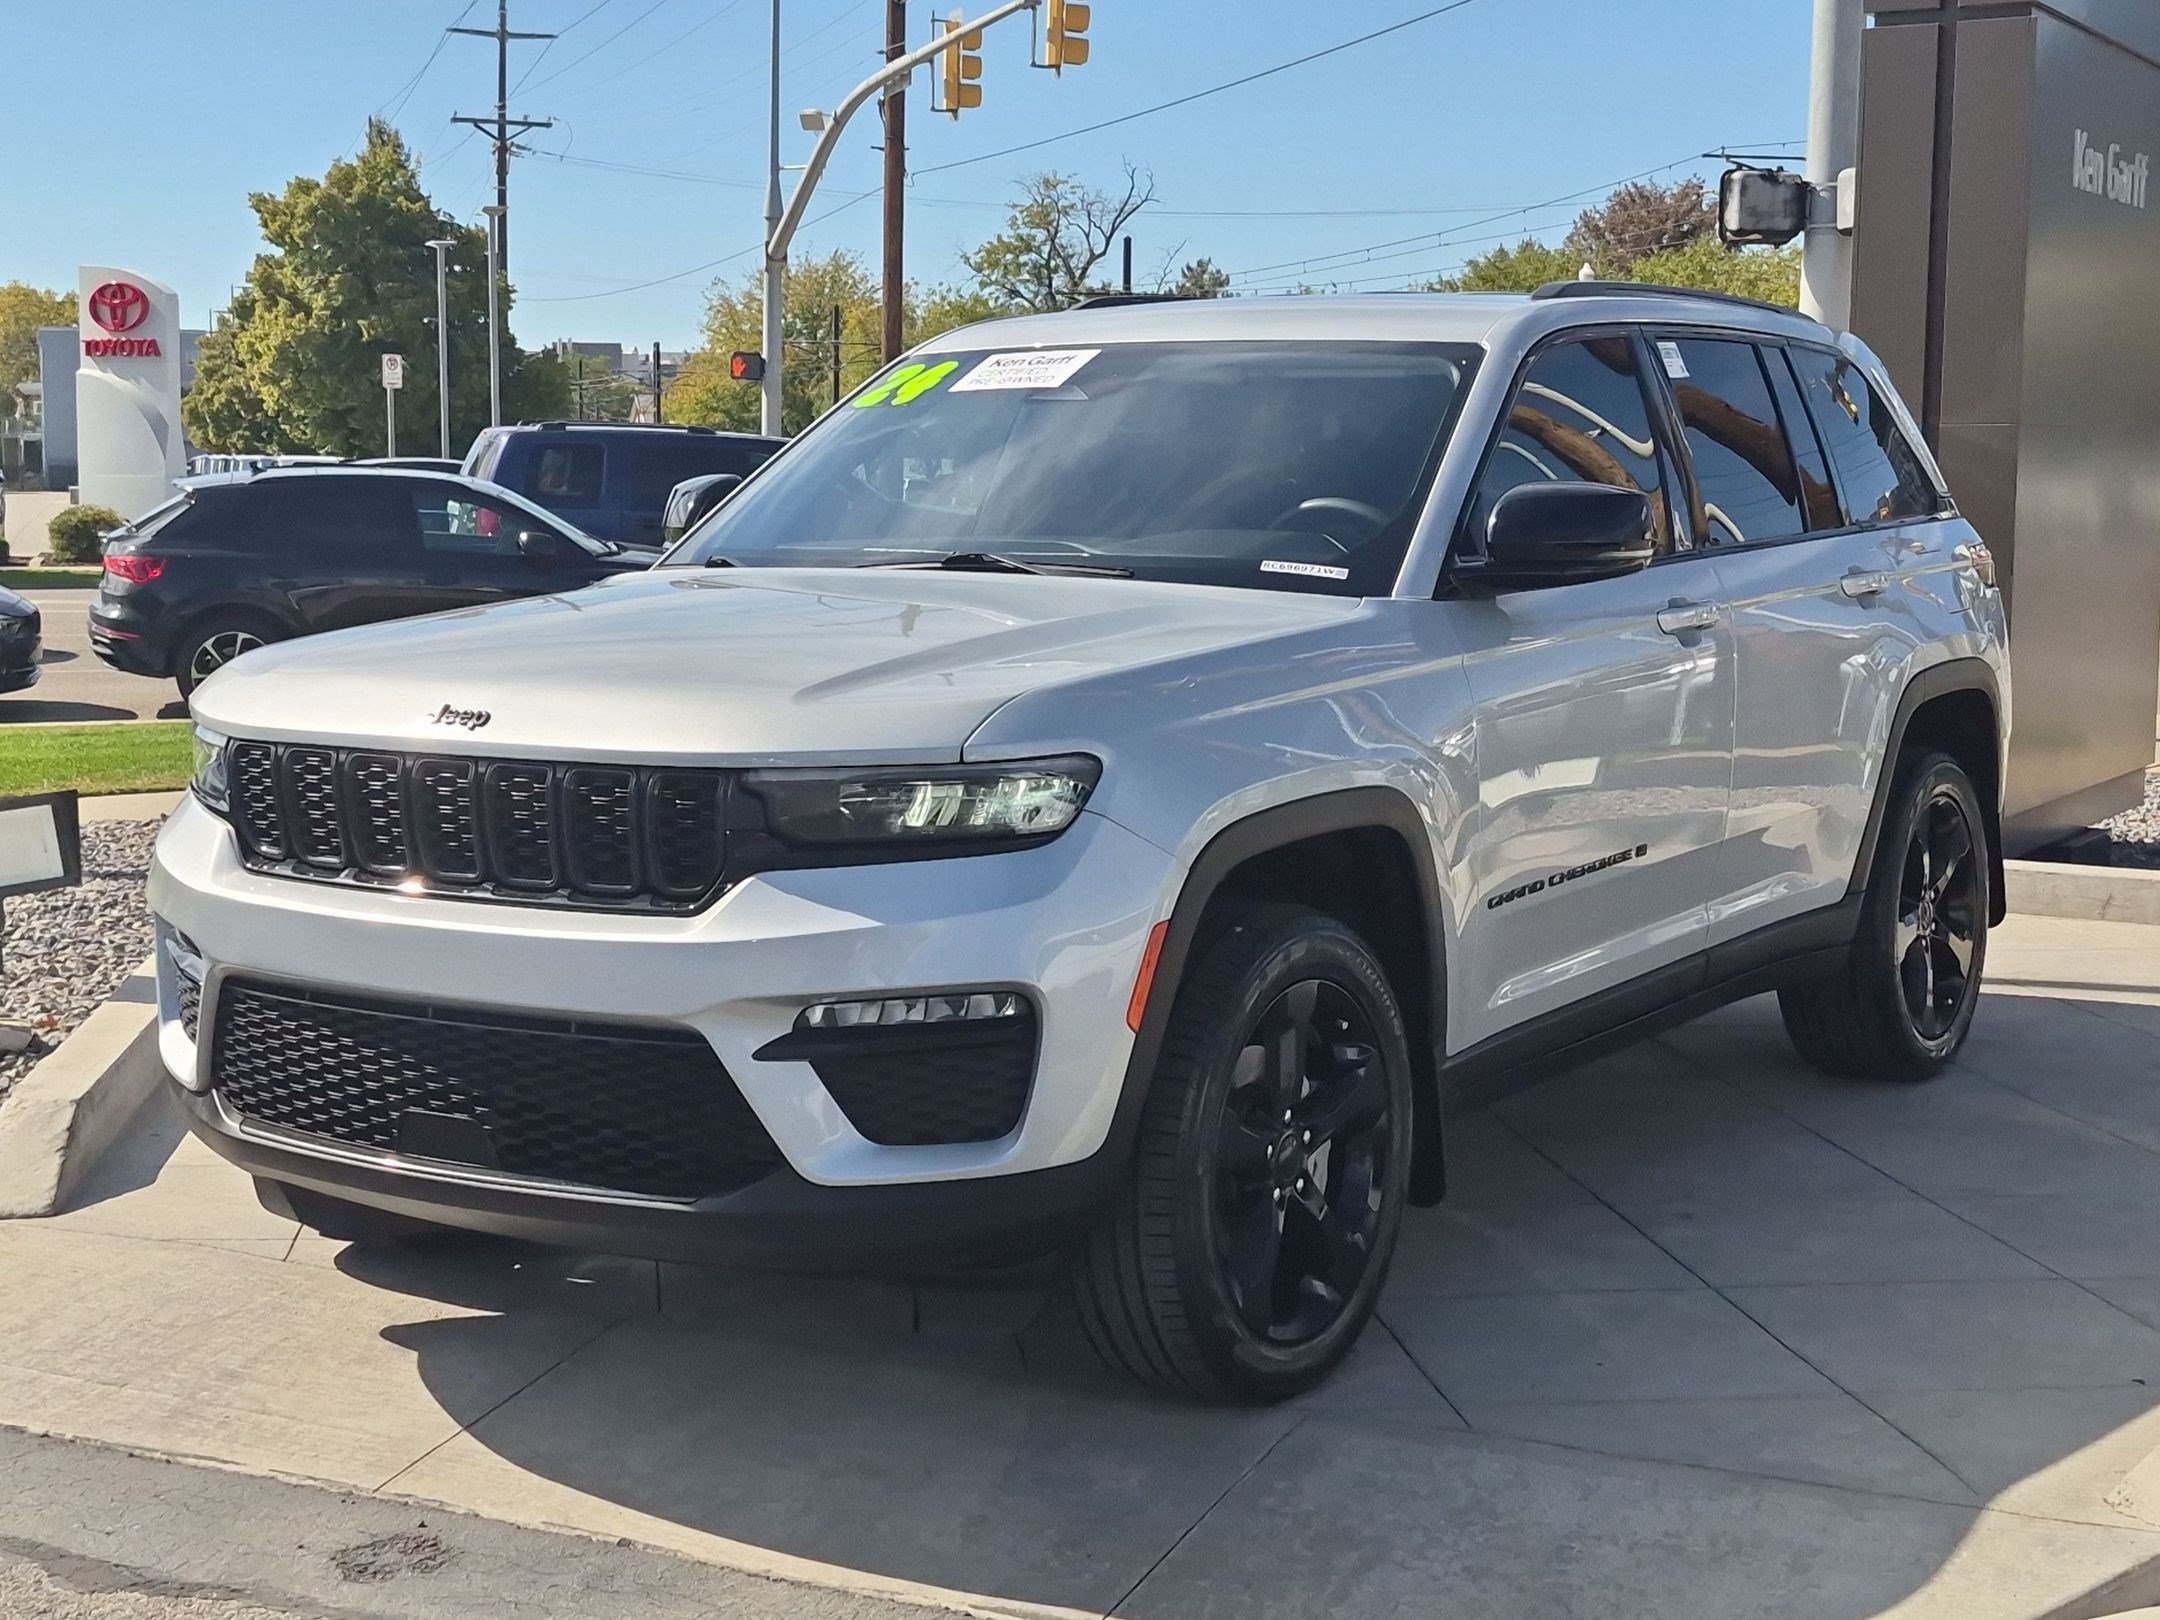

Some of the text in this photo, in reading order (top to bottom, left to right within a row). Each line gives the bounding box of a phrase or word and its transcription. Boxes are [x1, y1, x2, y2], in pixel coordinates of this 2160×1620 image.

[2073, 128, 2149, 209] Ken Garff
[81, 338, 161, 357] TOYOTA
[989, 353, 1079, 368] Ken Garff
[967, 375, 1056, 386] PRE-OWNED
[977, 366, 1049, 377] CERTIFIED
[428, 703, 492, 732] Jeep
[1487, 848, 1634, 910] GRAND CHEROKEE
